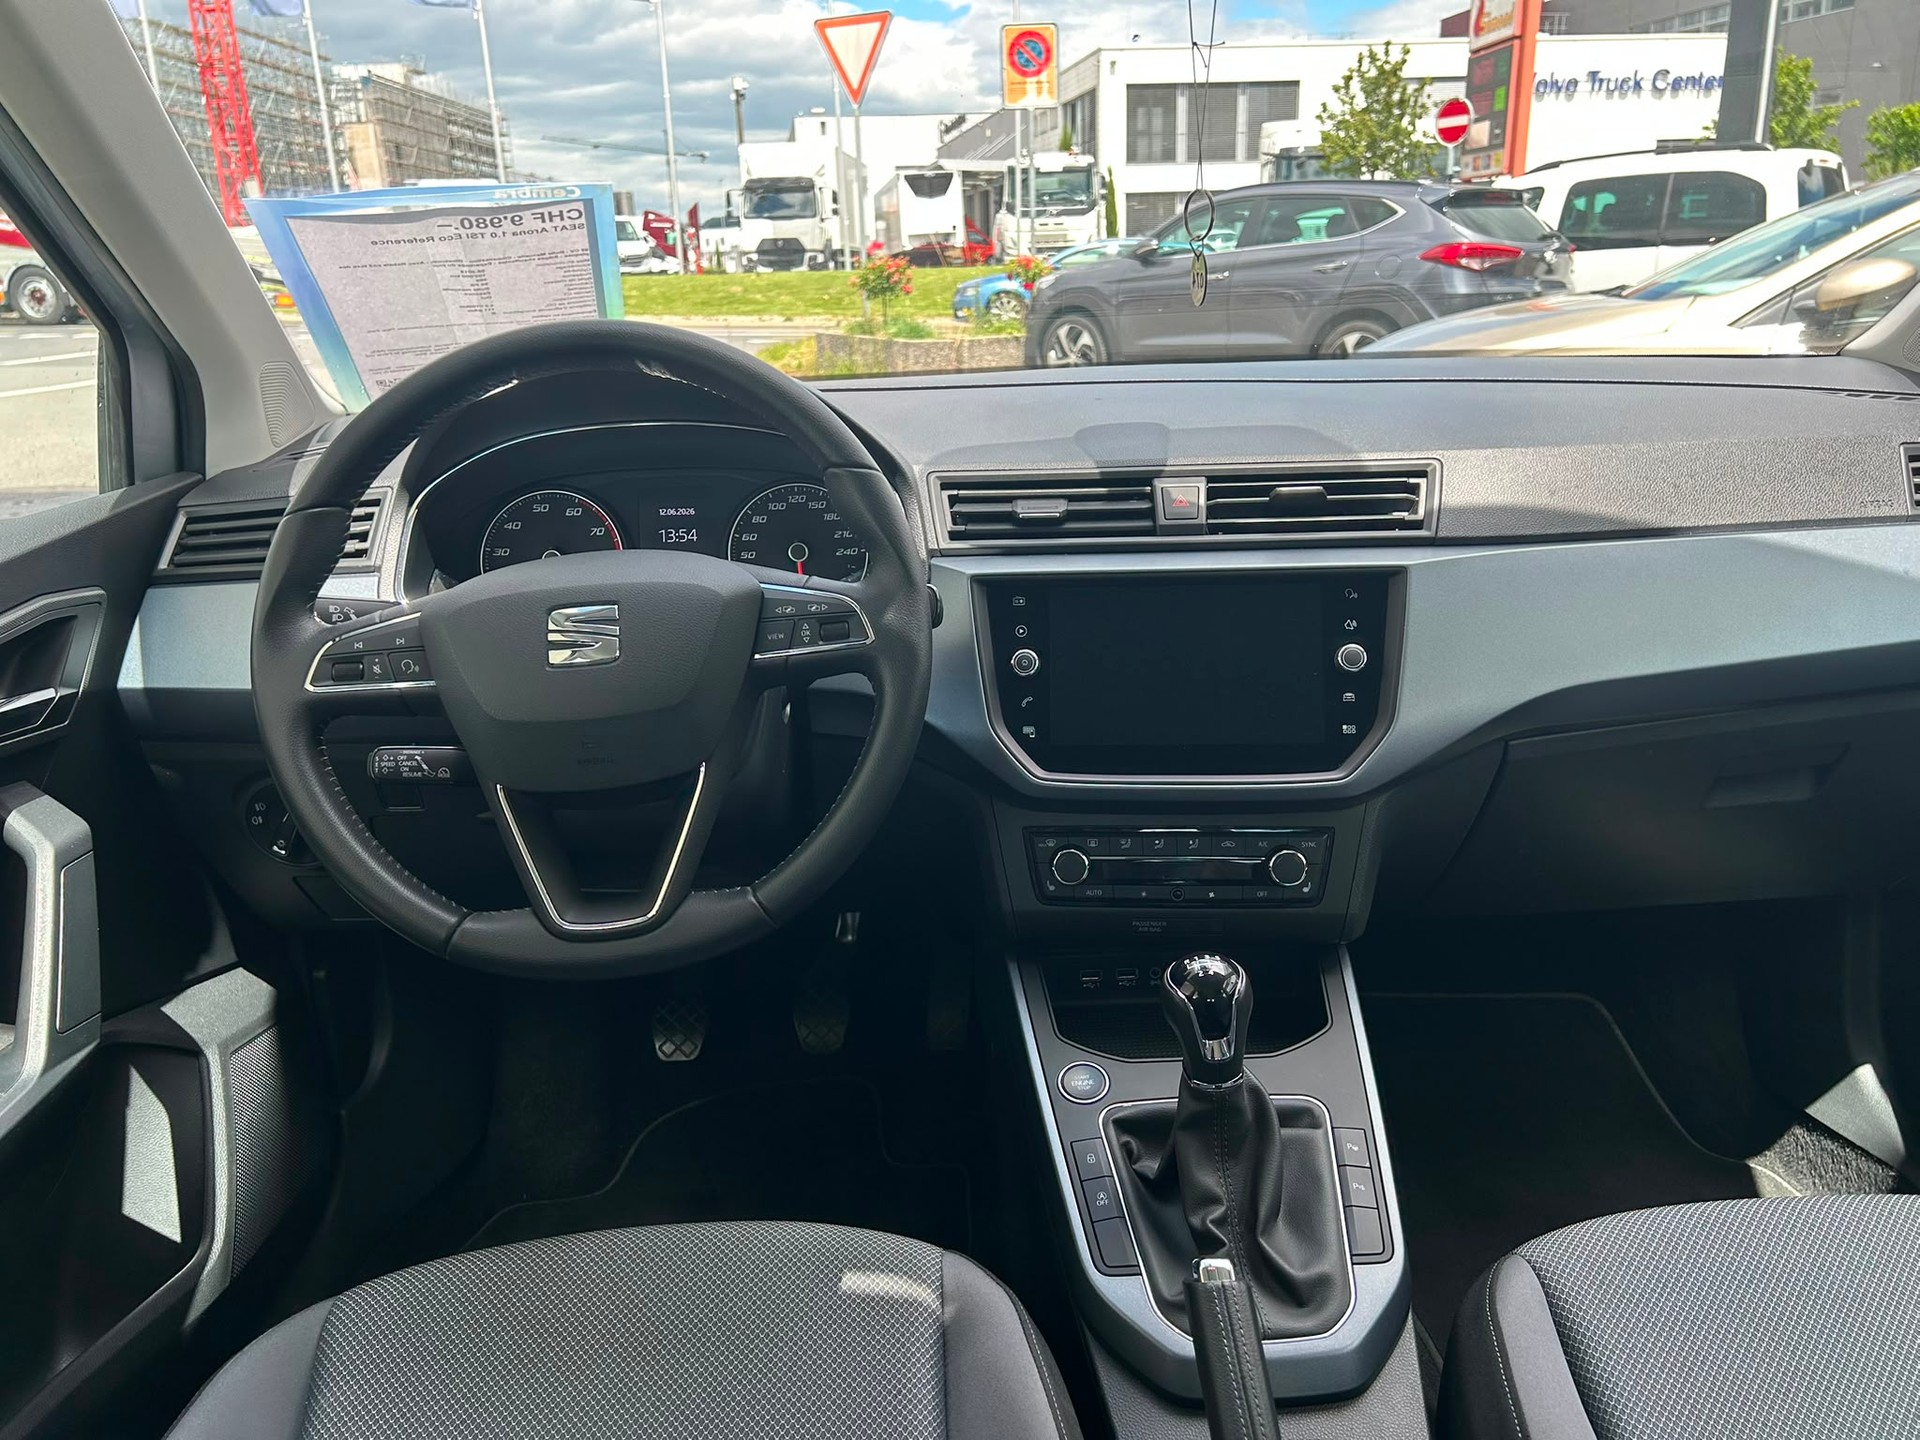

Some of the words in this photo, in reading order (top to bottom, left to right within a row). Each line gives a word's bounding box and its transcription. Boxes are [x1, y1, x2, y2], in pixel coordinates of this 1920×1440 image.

[1587, 70, 1644, 92] Truck
[1652, 69, 1725, 92] Center
[787, 495, 806, 503] 120
[532, 504, 549, 512] 50
[768, 502, 787, 510] 100
[808, 501, 827, 509] 150
[565, 508, 582, 516] 60
[659, 507, 695, 516] 12.06.2026
[752, 515, 767, 523] 80
[504, 521, 521, 530] 40
[590, 527, 605, 536] 70
[658, 528, 698, 542] 13:54
[742, 533, 758, 541] 60
[492, 548, 510, 556] 30
[740, 551, 756, 559] 50
[836, 547, 858, 556] 240
